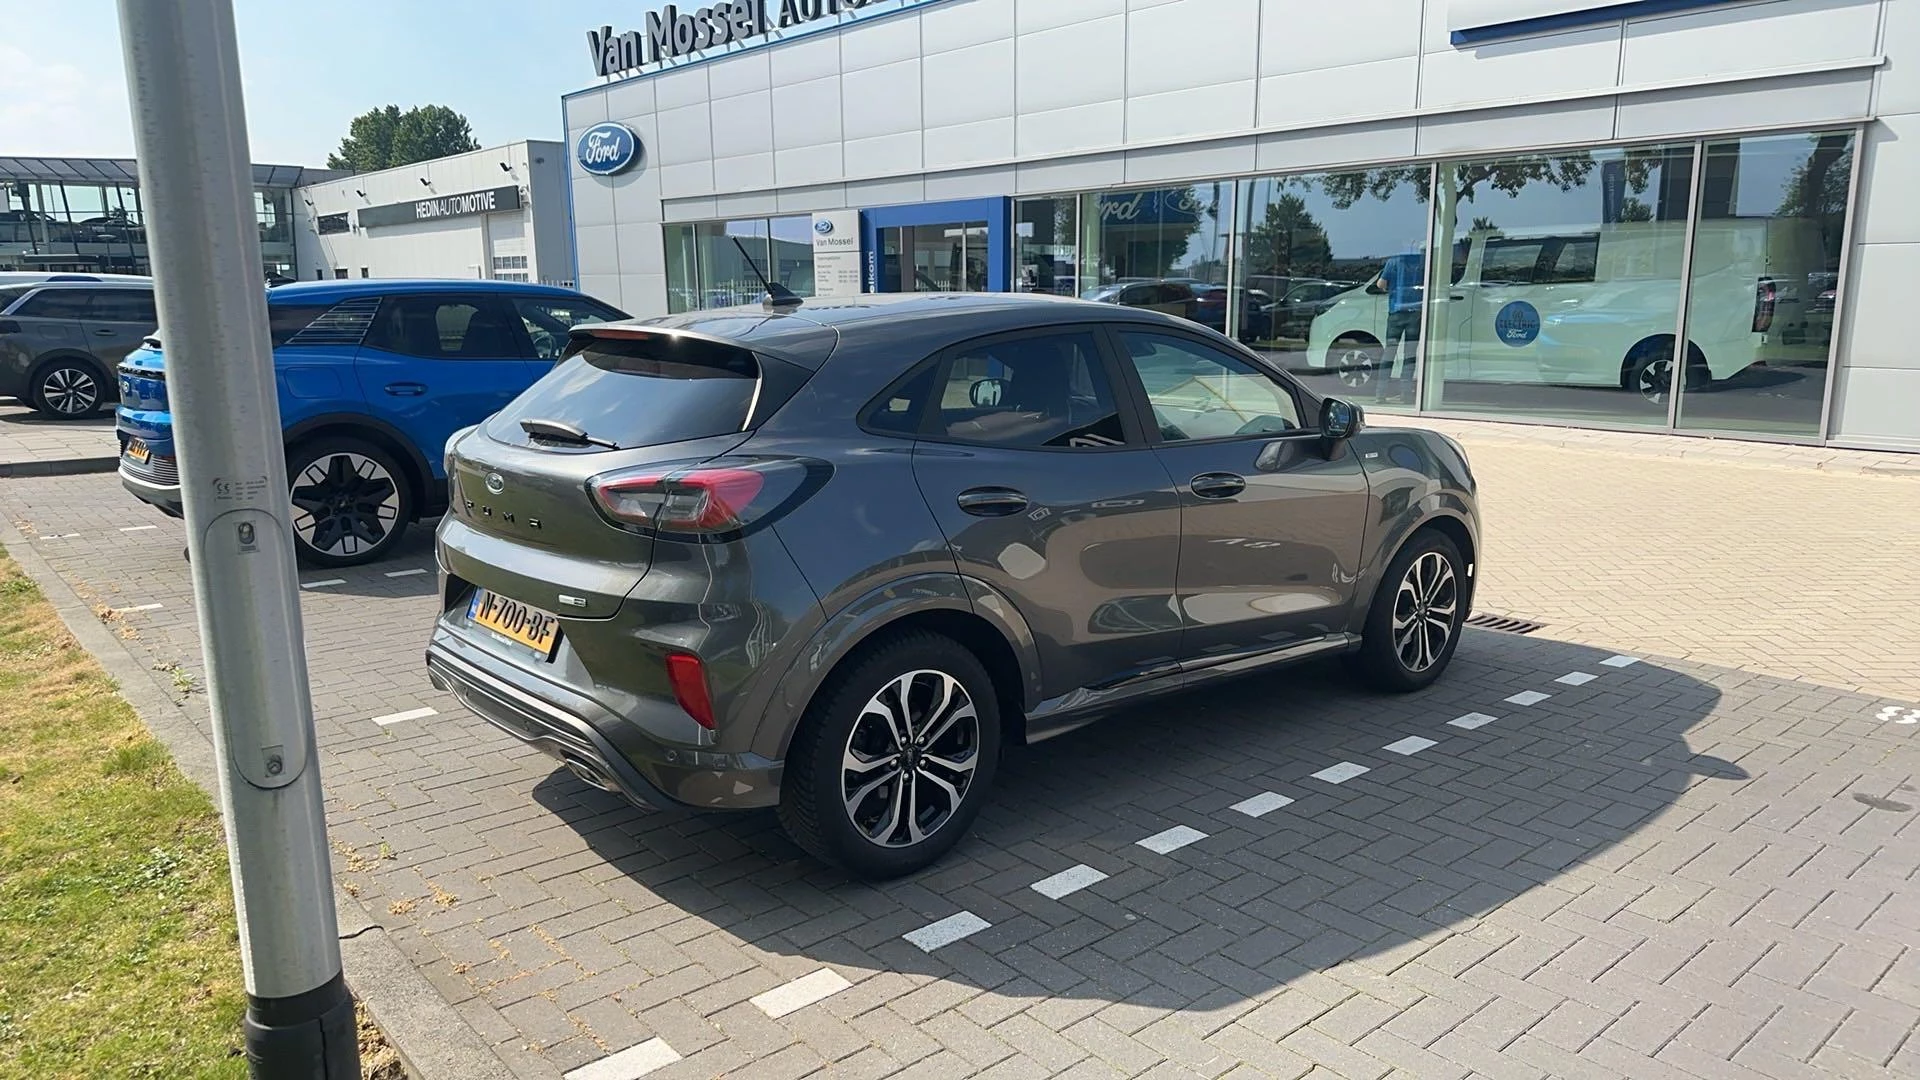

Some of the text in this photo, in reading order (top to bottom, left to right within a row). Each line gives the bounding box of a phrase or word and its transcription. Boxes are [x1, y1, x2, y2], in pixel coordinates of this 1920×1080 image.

[587, 26, 642, 76] Van
[646, 0, 767, 62] Mossel
[586, 131, 620, 164] Ford
[828, 237, 853, 246] Mossel
[1506, 329, 1528, 339] Ford
[480, 592, 554, 644] N-700-BF
